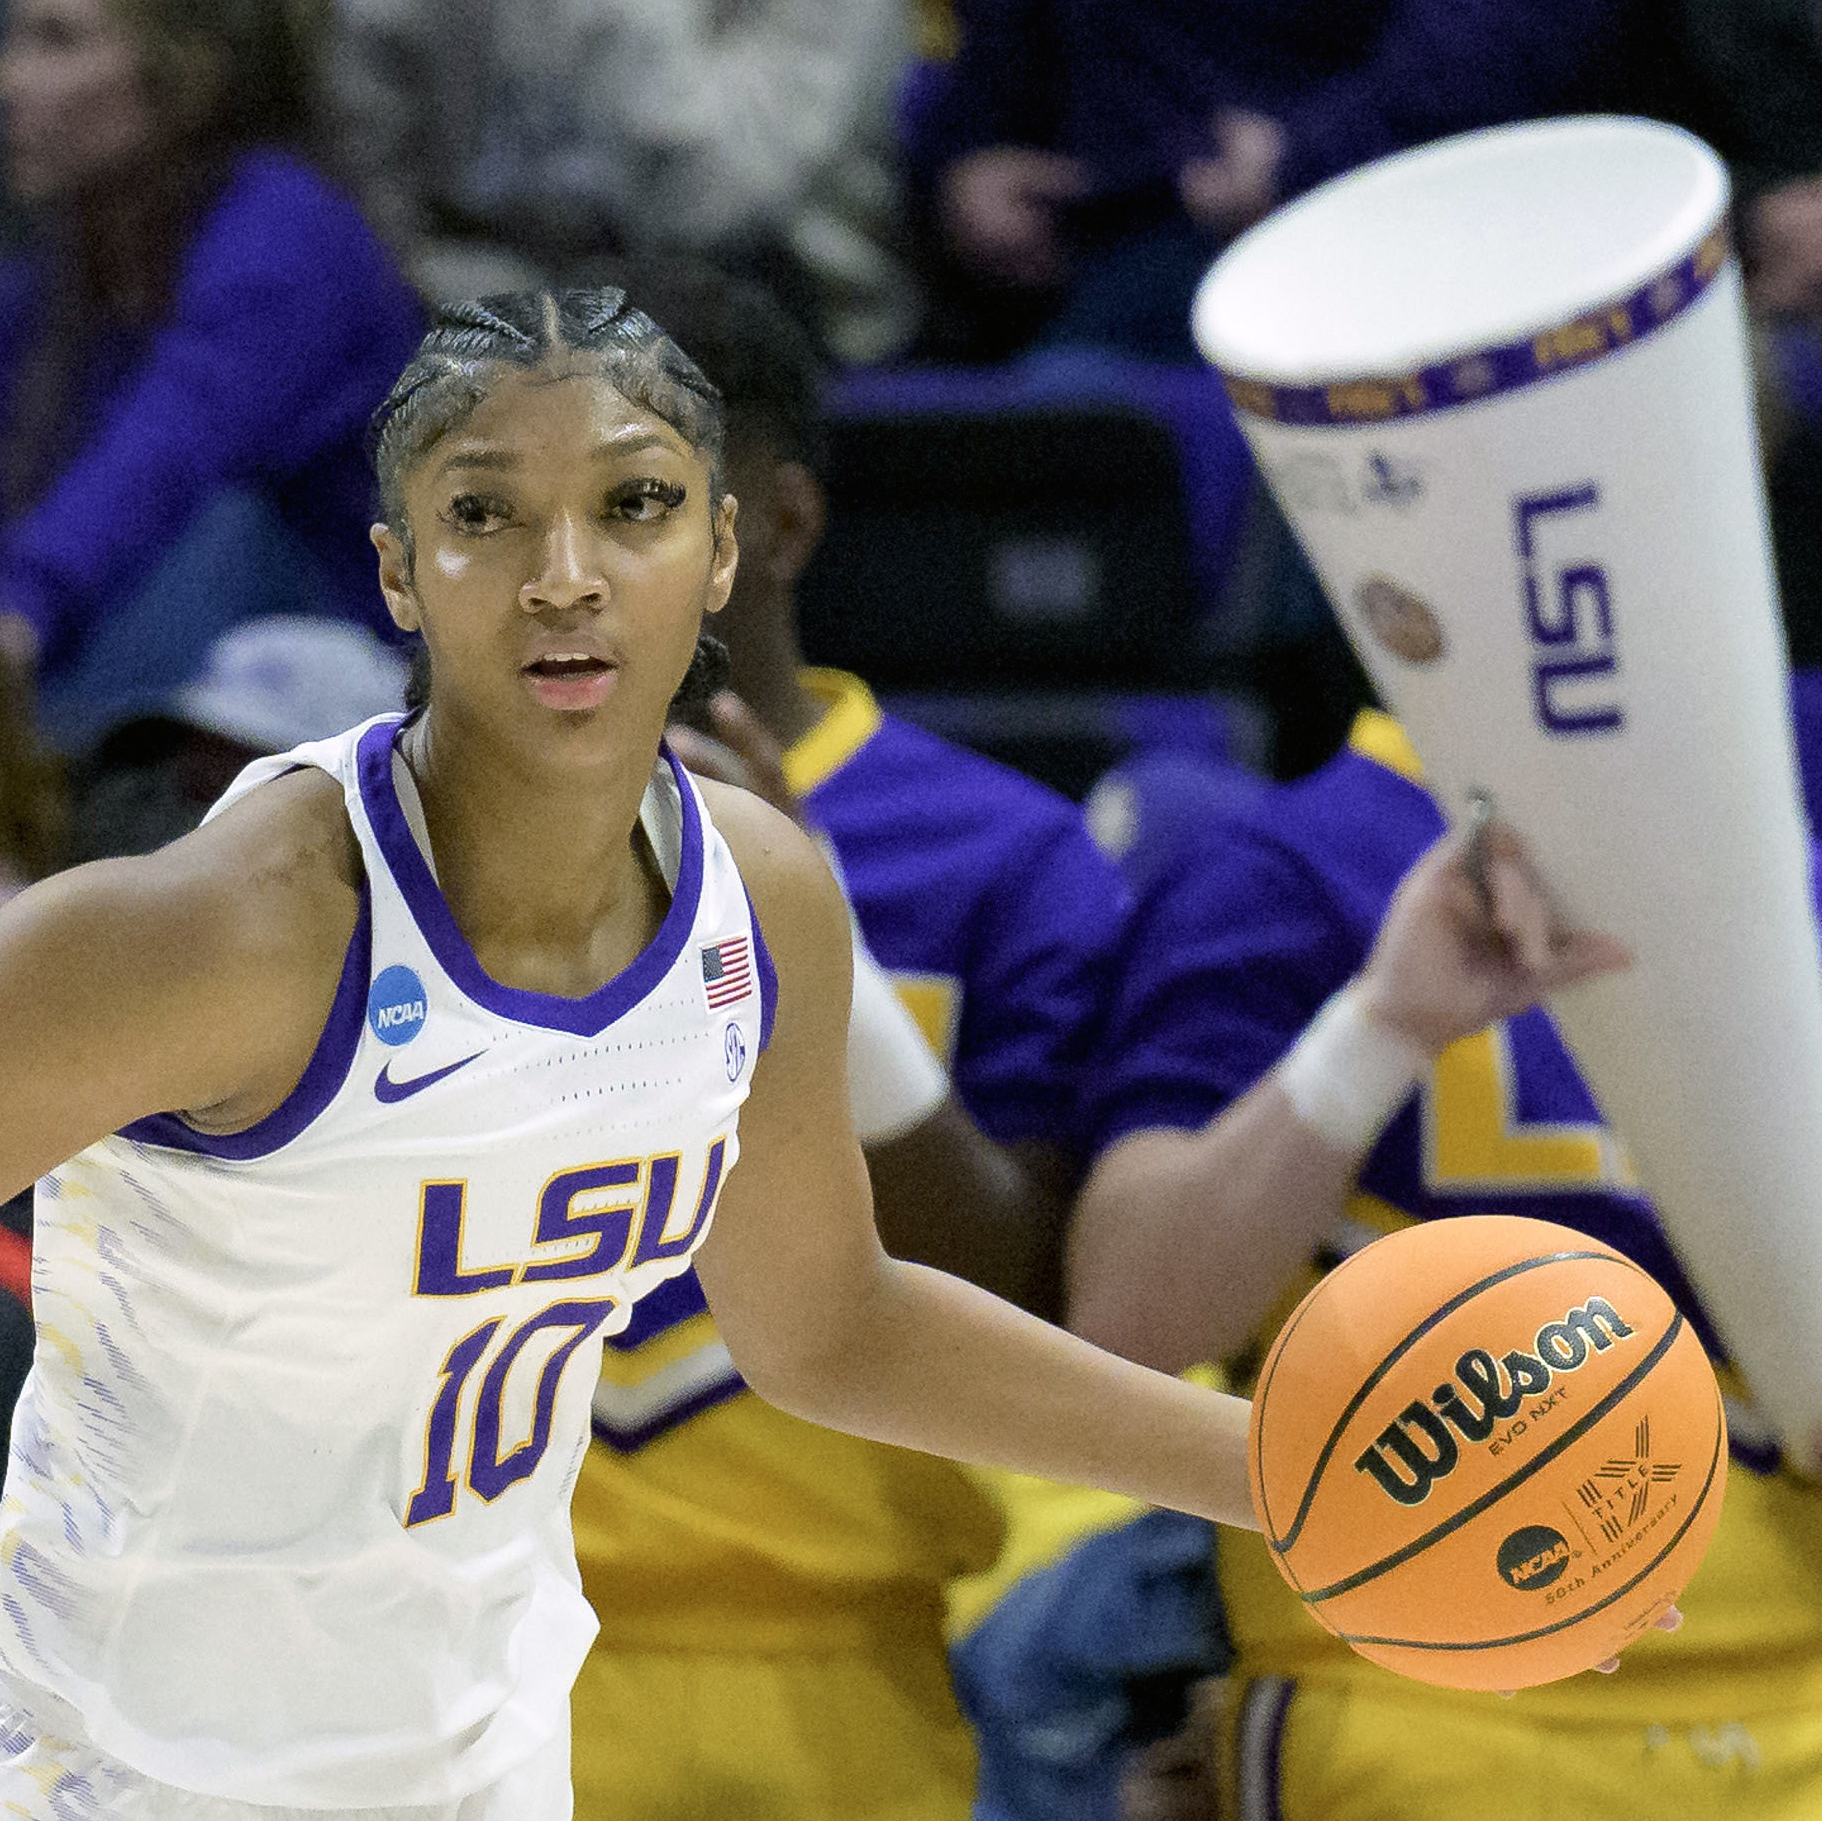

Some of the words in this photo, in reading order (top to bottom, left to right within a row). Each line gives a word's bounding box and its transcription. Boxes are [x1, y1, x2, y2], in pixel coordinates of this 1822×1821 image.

[1511, 478, 1625, 738] LSU
[377, 1000, 424, 1029] NCAA
[411, 1134, 728, 1298] LSU
[403, 1295, 618, 1529] 10
[1353, 1294, 1638, 1508] Wilson
[1487, 1418, 1529, 1458] EVO
[1529, 1386, 1570, 1422] NXT
[1508, 1540, 1570, 1586] NCAA
[1544, 1576, 1587, 1607] 50th
[1590, 1493, 1679, 1580] Anniversary
